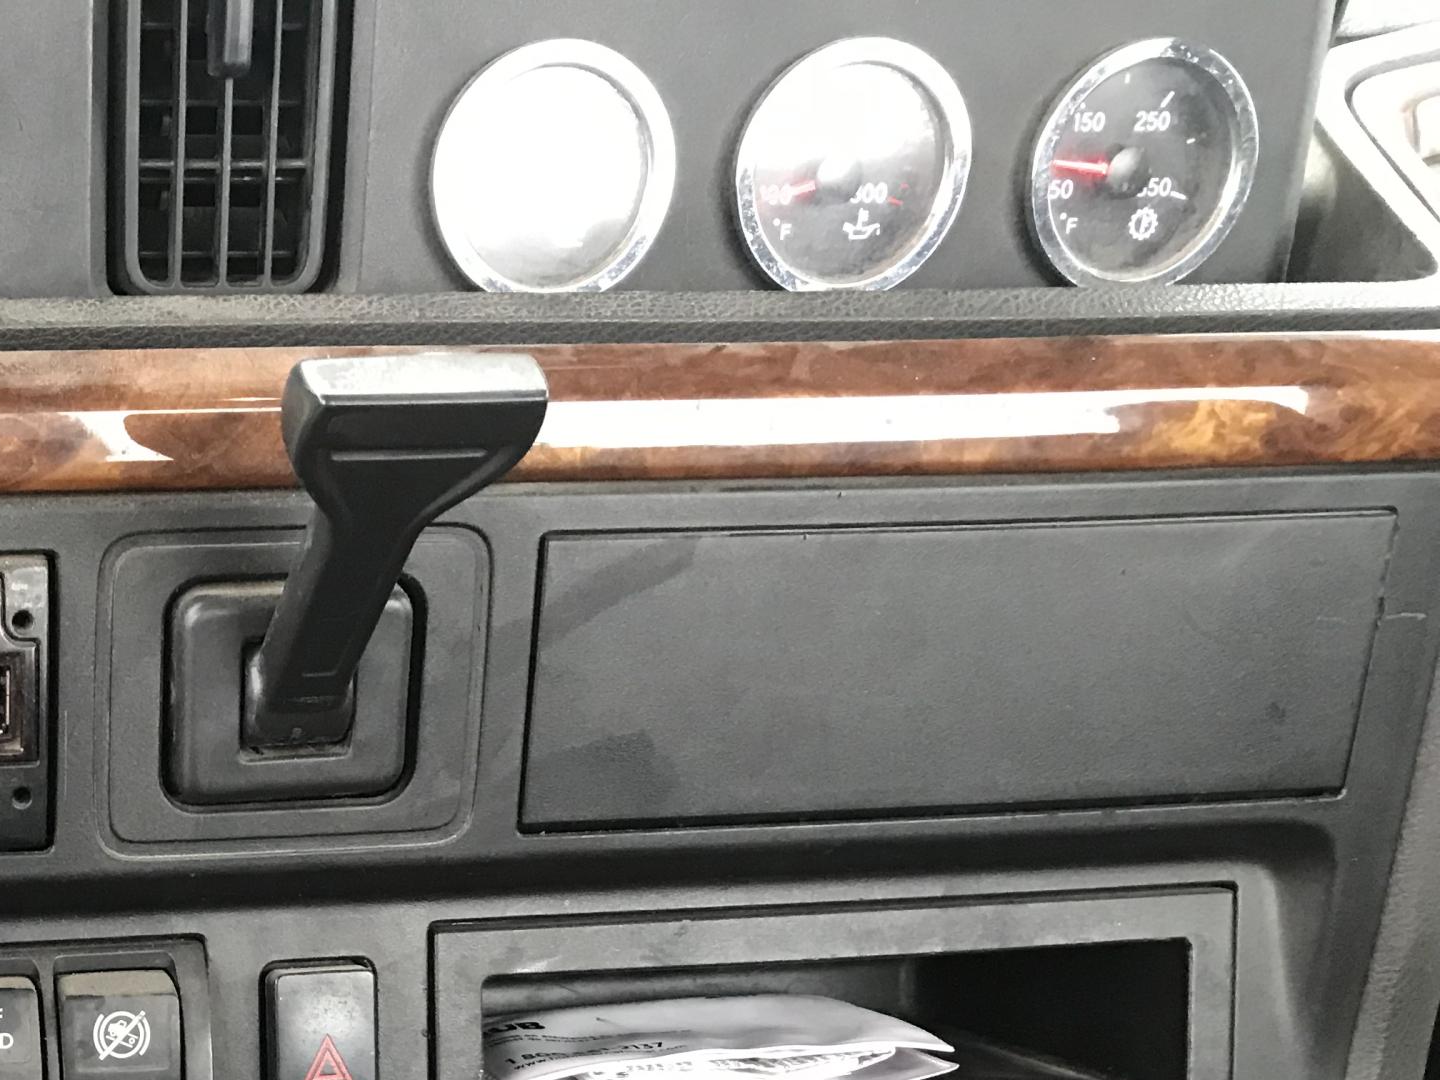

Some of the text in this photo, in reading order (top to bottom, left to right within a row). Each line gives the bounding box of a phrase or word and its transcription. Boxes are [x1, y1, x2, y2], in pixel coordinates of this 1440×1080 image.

[1073, 111, 1106, 132] 150
[1133, 110, 1171, 132] 250
[1047, 179, 1074, 201] 50
